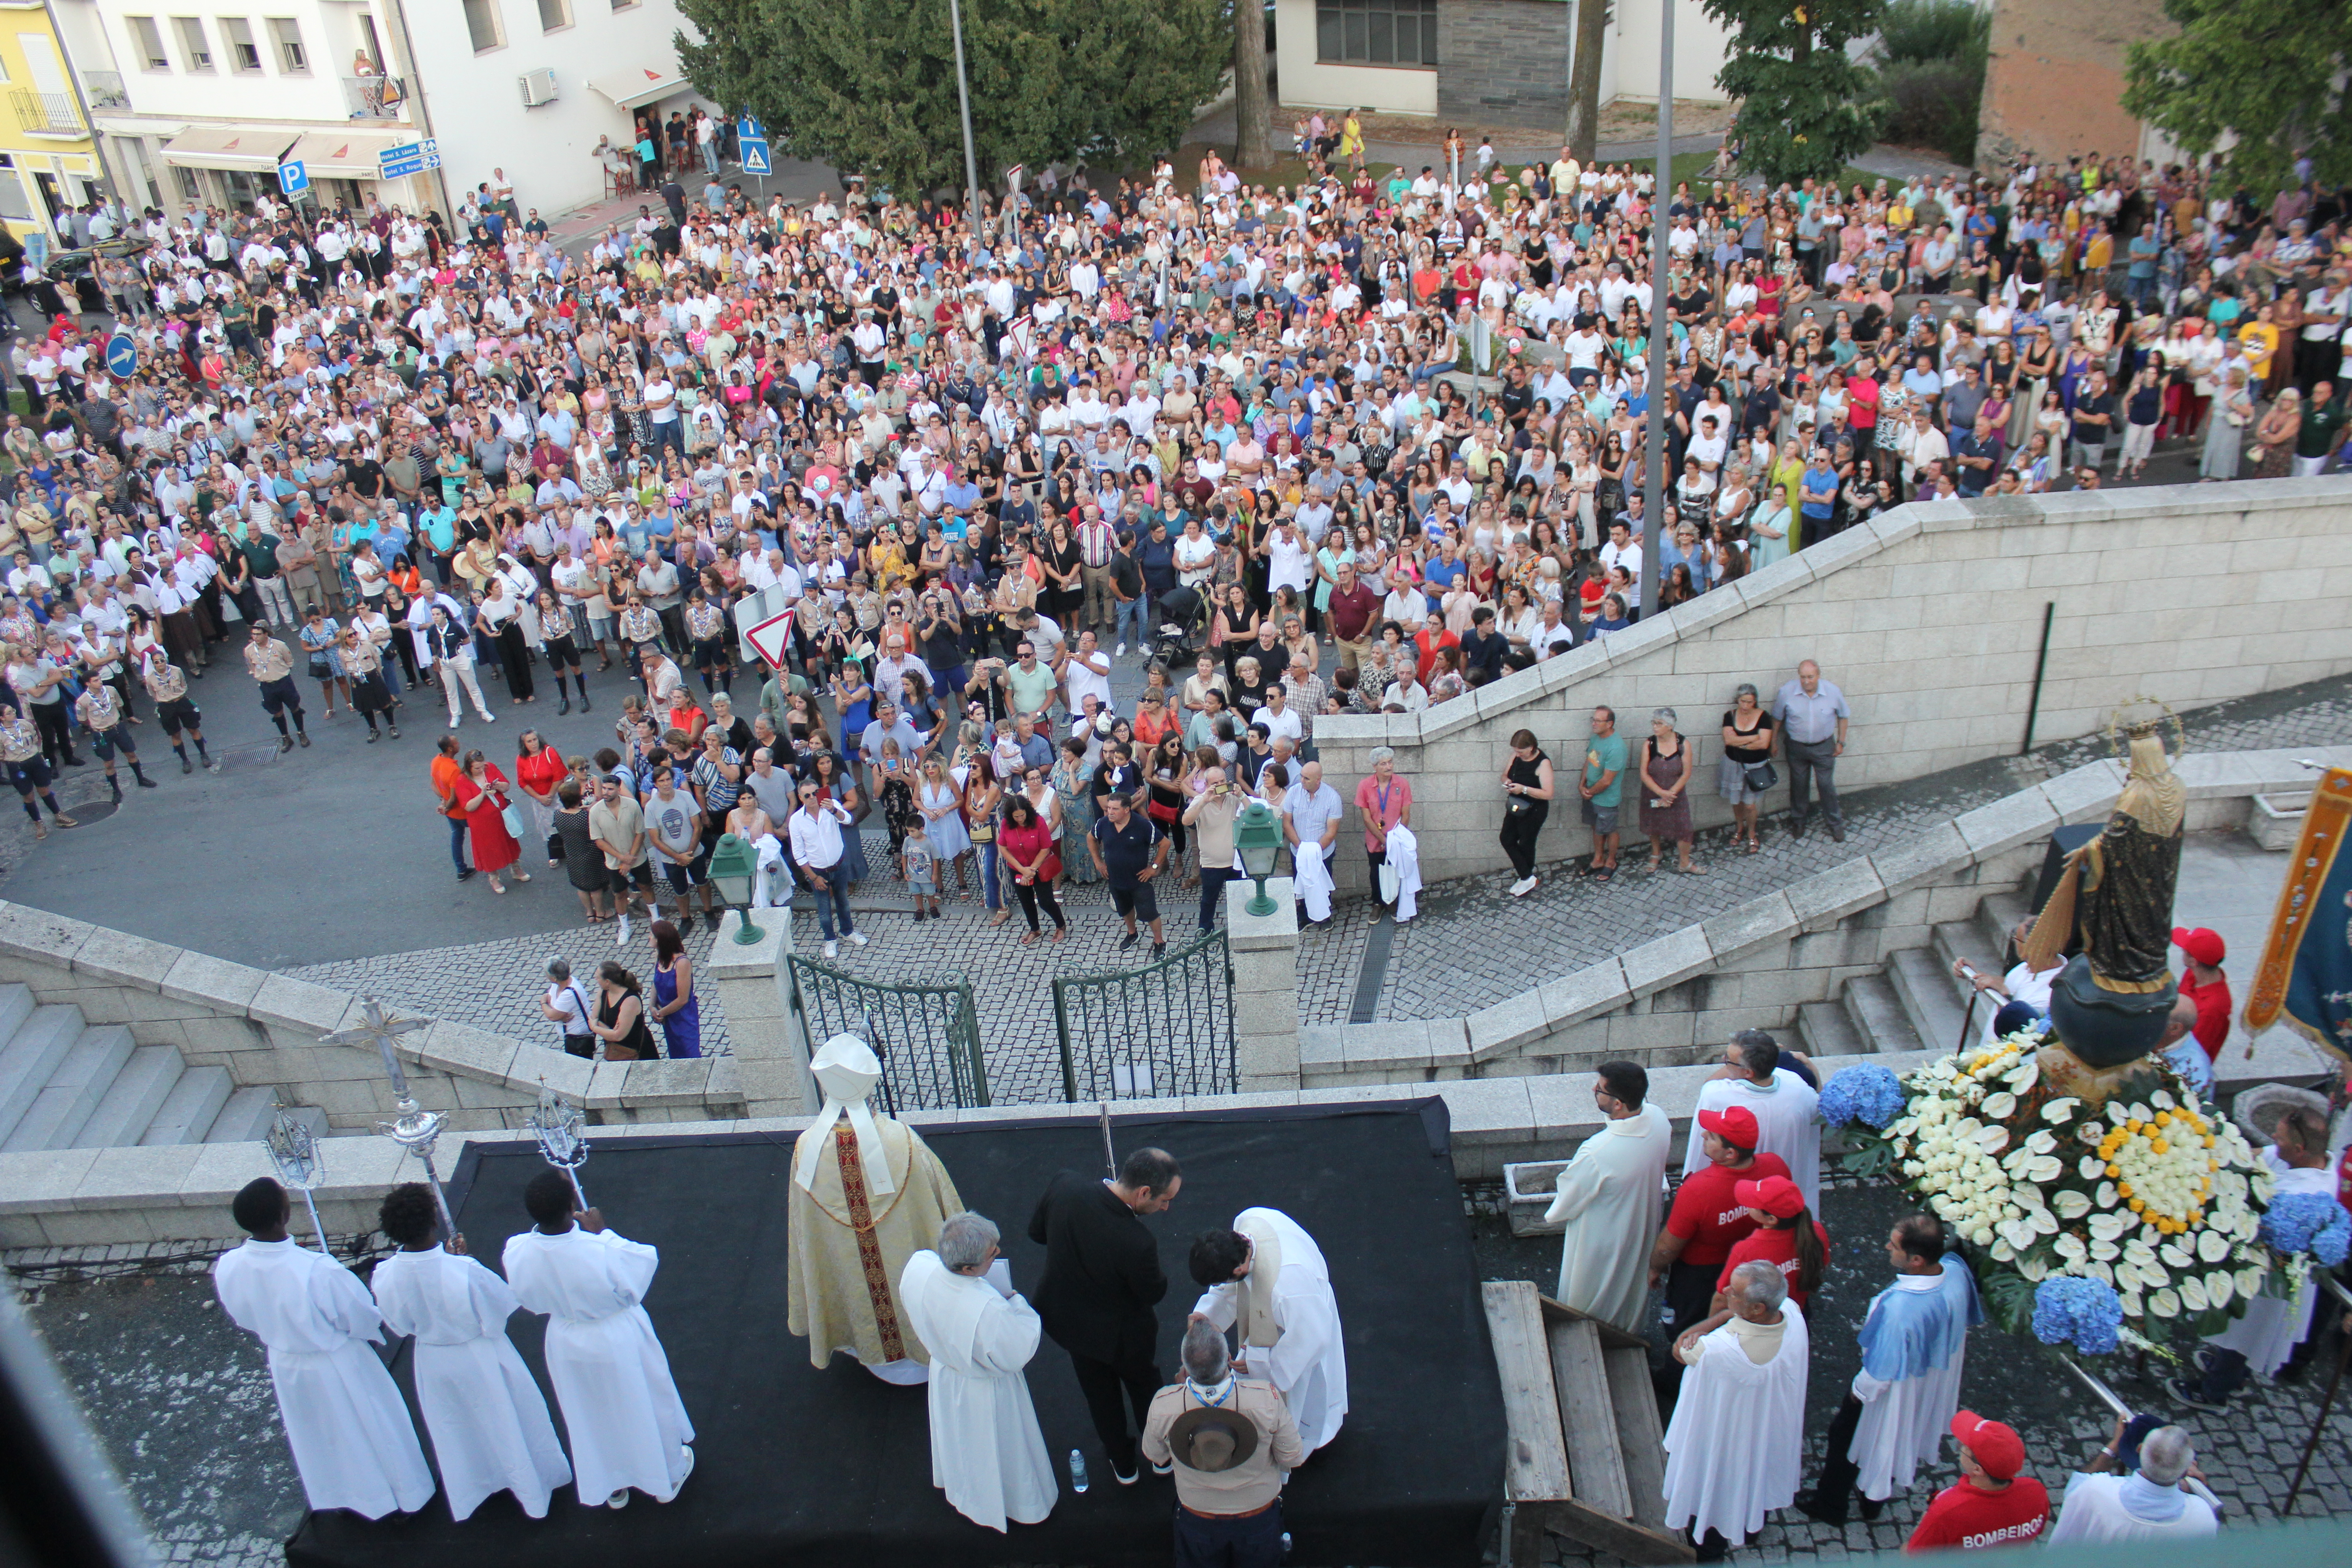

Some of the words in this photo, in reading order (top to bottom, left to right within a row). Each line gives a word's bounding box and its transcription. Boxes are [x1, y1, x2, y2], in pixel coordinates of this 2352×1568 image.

[284, 165, 300, 190] P
[291, 191, 306, 200] TAXIS
[941, 532, 959, 541] VANS
[1240, 695, 1262, 708] FASHION
[1718, 1205, 1750, 1225] BOMB
[1962, 1514, 2044, 1548] BOMBEIROS
